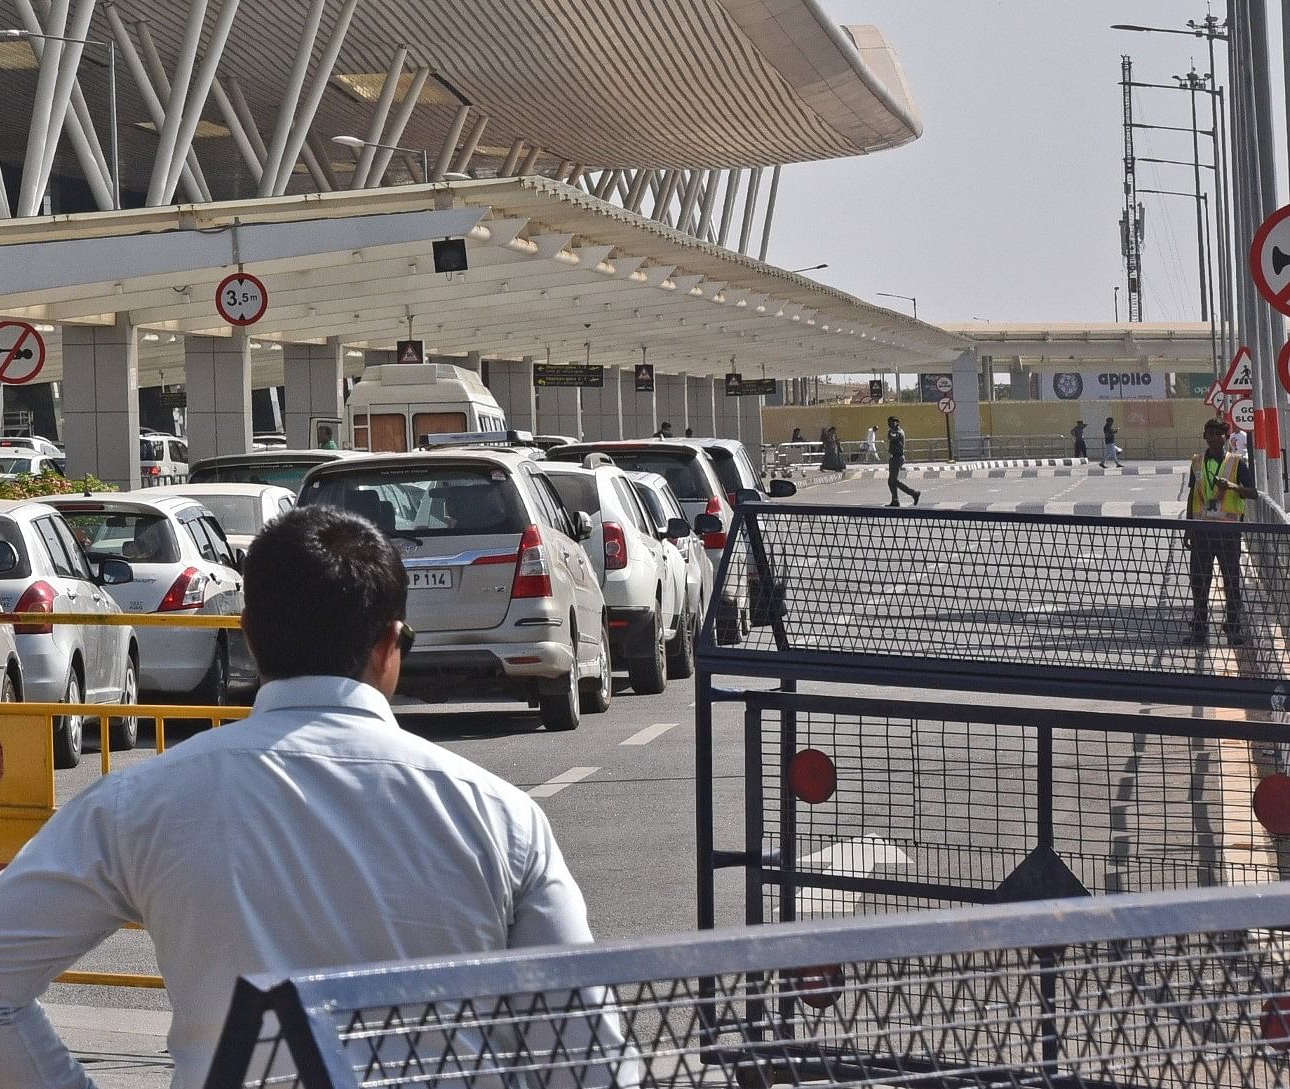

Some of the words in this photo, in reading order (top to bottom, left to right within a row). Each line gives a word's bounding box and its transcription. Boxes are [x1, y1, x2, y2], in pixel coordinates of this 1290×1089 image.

[1098, 373, 1152, 391] apollo
[1235, 415, 1254, 423] SLO
[424, 573, 446, 585] 114
